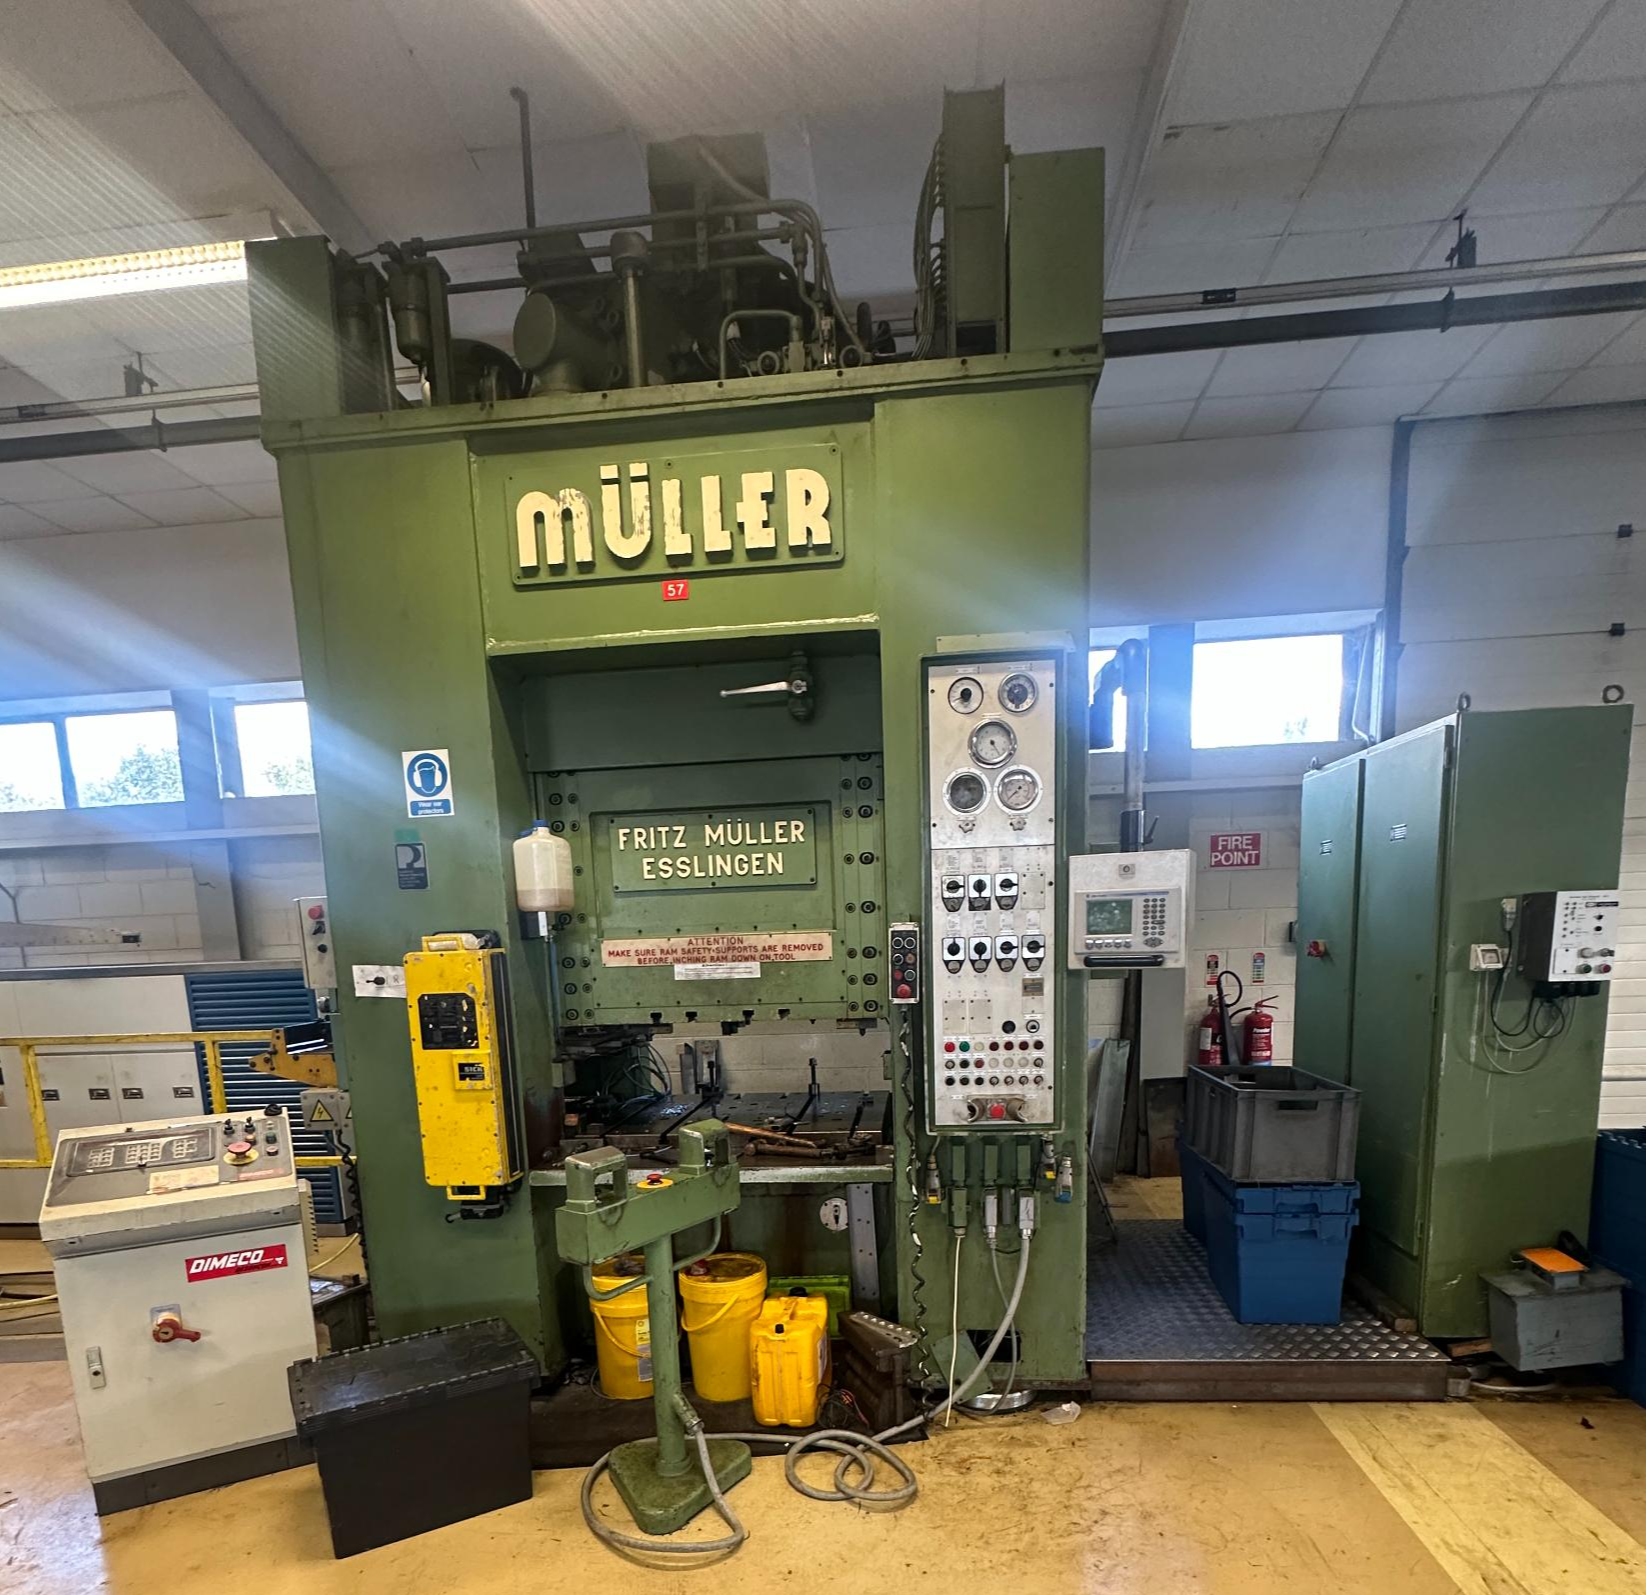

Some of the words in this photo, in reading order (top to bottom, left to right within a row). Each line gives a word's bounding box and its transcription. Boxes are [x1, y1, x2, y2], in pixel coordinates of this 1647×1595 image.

[516, 462, 832, 568] MÜLLER
[667, 584, 685, 597] 57
[618, 826, 687, 850] FRITZ
[704, 818, 805, 847] MÜLLER
[1218, 835, 1253, 850] FIRE
[1211, 850, 1259, 866] POINT
[642, 852, 784, 880] ESSLINGEN
[688, 936, 744, 946] ATTENTION
[608, 949, 631, 957] MAKE
[634, 948, 657, 956] SURE
[660, 948, 678, 956] RAM
[681, 946, 712, 955] SAFETY
[716, 945, 759, 954] SUPPORTS
[762, 944, 778, 953] ARE
[782, 943, 824, 952] REMOVED
[637, 956, 668, 965] BEFORE
[672, 955, 707, 964] INCHING
[710, 954, 727, 963] RAM
[731, 953, 756, 962] DOWN
[760, 953, 771, 961] ON
[773, 952, 796, 961] TOOL
[189, 1249, 264, 1274] DIMECO
